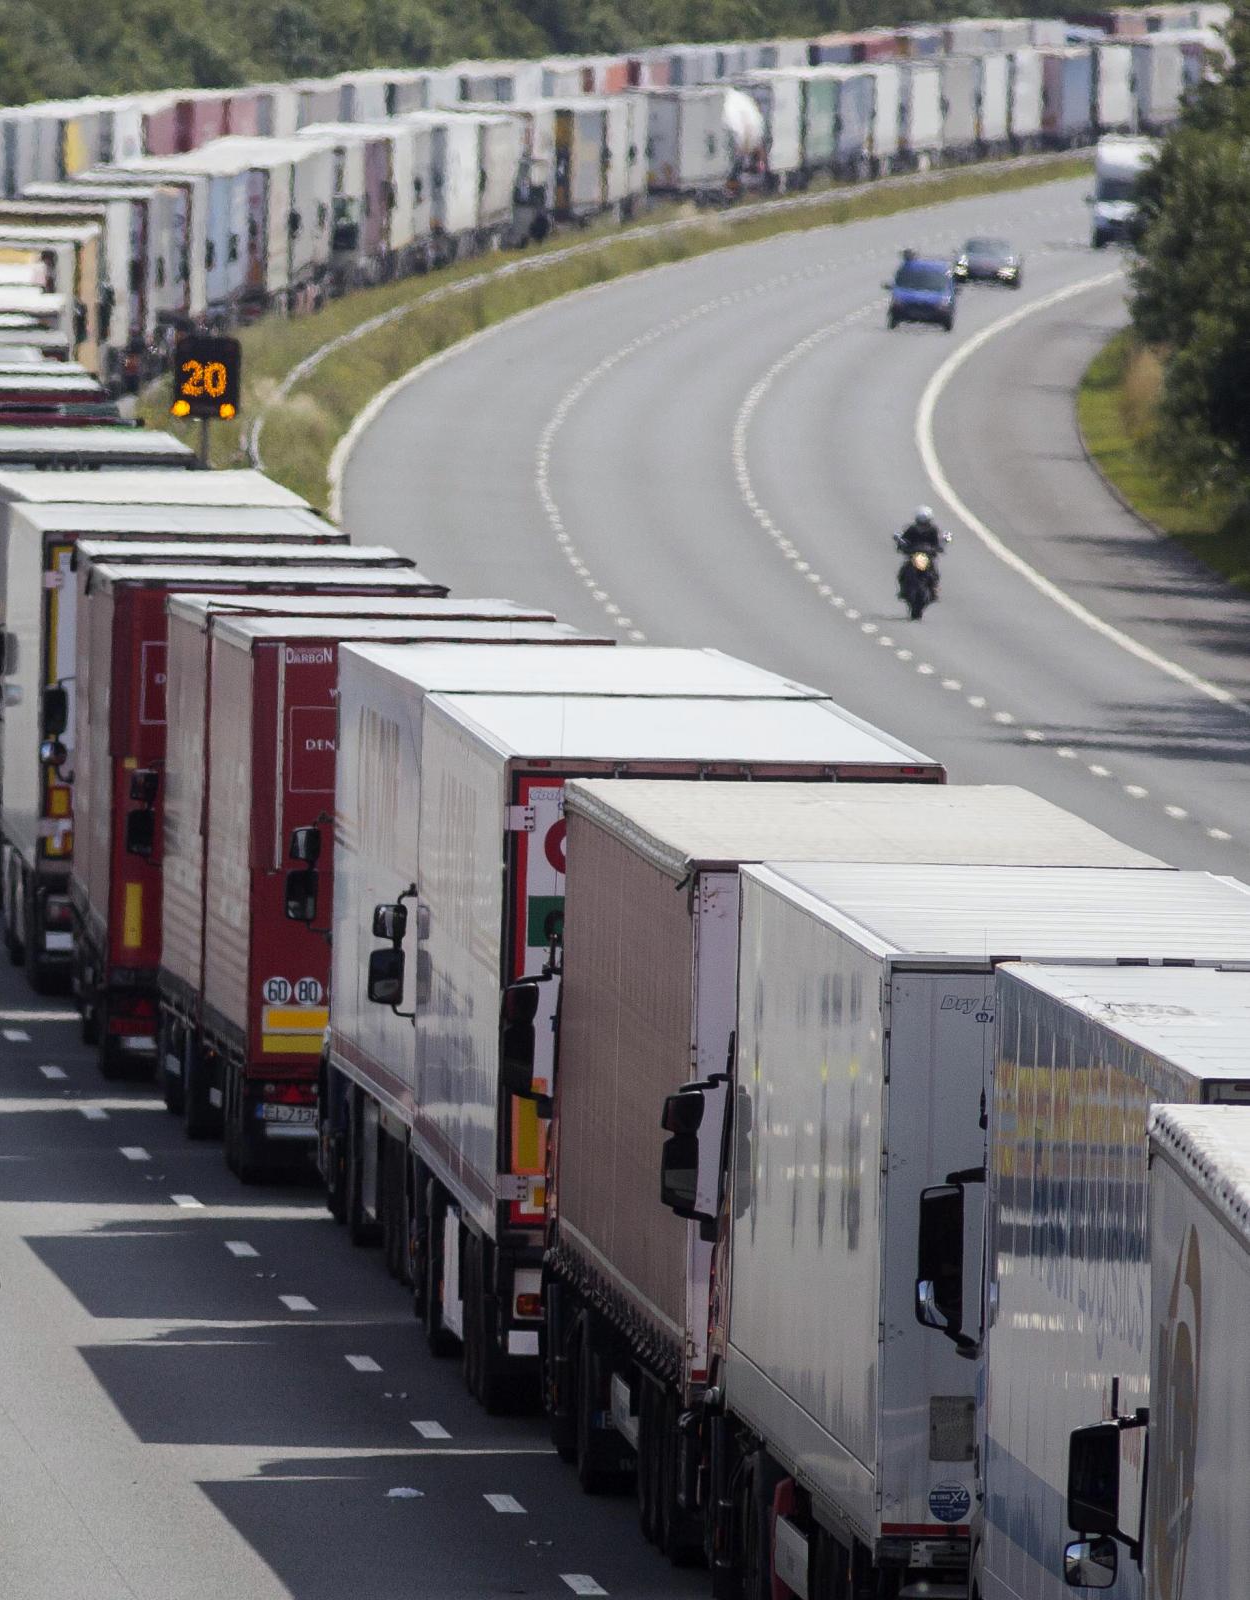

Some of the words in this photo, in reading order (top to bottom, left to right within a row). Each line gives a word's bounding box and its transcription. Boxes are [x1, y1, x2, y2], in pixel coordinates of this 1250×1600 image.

[181, 360, 227, 397] 20
[268, 980, 288, 1001] 60
[299, 980, 318, 1001] 80
[940, 994, 979, 1015] Dry
